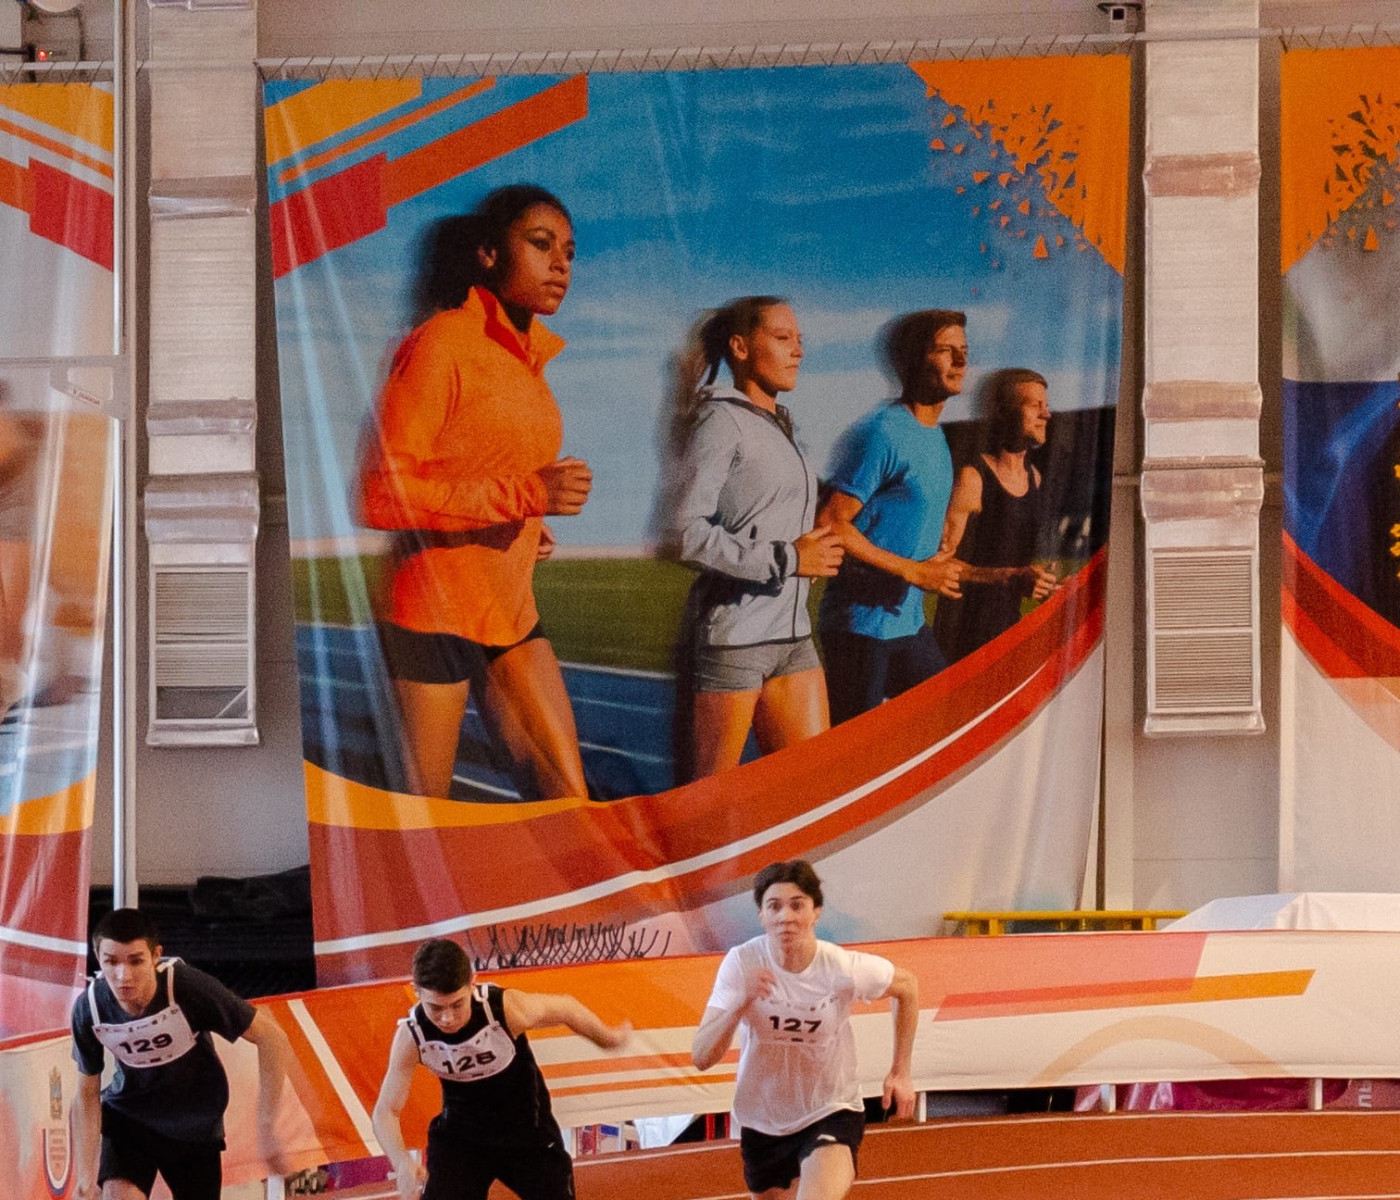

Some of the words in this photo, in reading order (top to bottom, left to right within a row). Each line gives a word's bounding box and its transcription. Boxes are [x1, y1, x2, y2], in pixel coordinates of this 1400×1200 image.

[769, 1015, 822, 1033] 127
[119, 1033, 173, 1054] 129
[442, 1050, 496, 1075] 128
